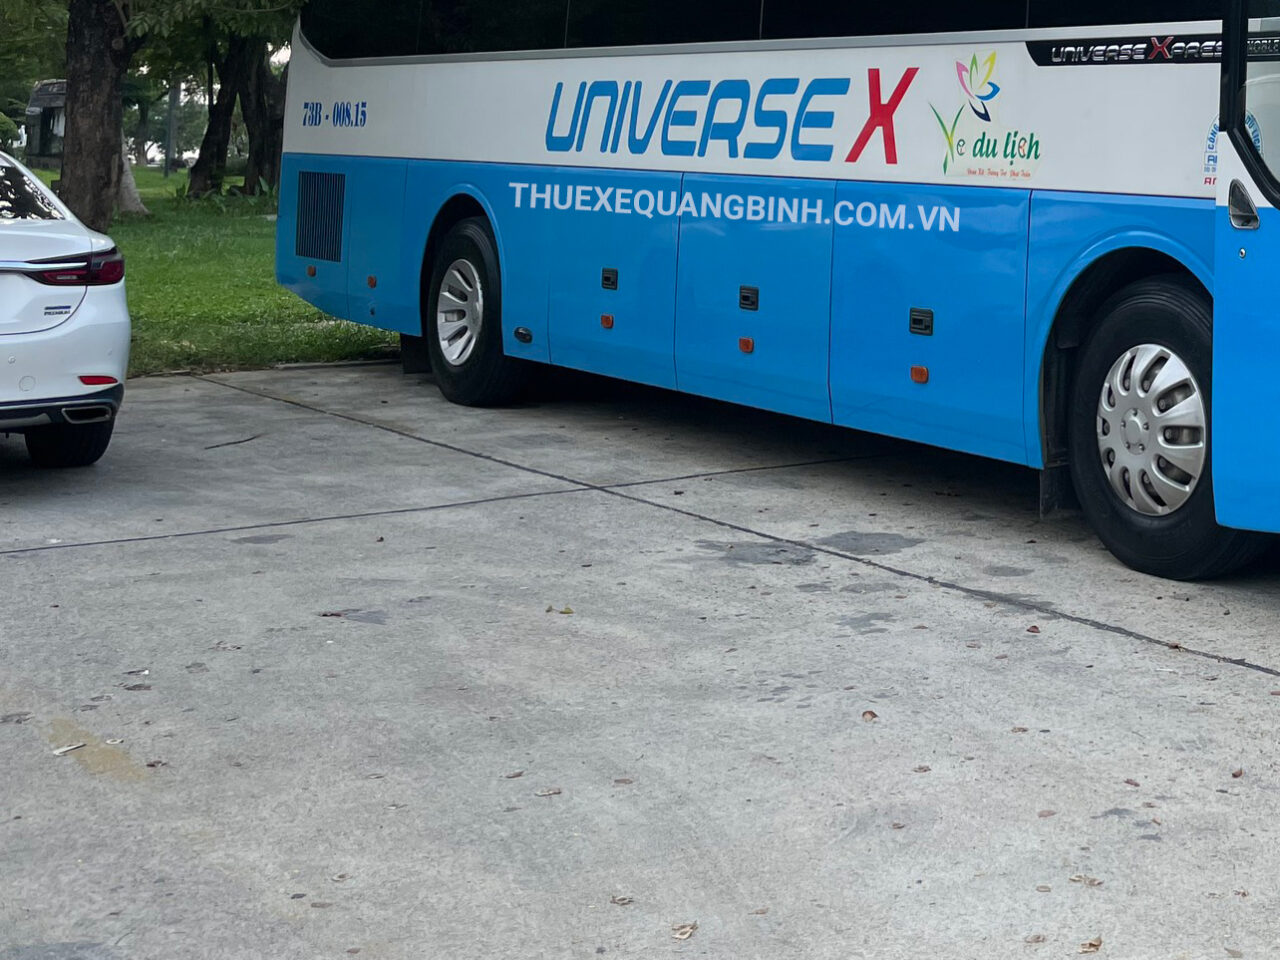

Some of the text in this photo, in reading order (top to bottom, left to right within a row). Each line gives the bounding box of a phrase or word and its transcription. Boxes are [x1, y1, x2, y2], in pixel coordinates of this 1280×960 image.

[302, 102, 322, 127] 73B
[332, 101, 367, 128] 008.15
[972, 131, 999, 159] du
[508, 182, 961, 232] THUEXEQUANGBINH.COM.VN
